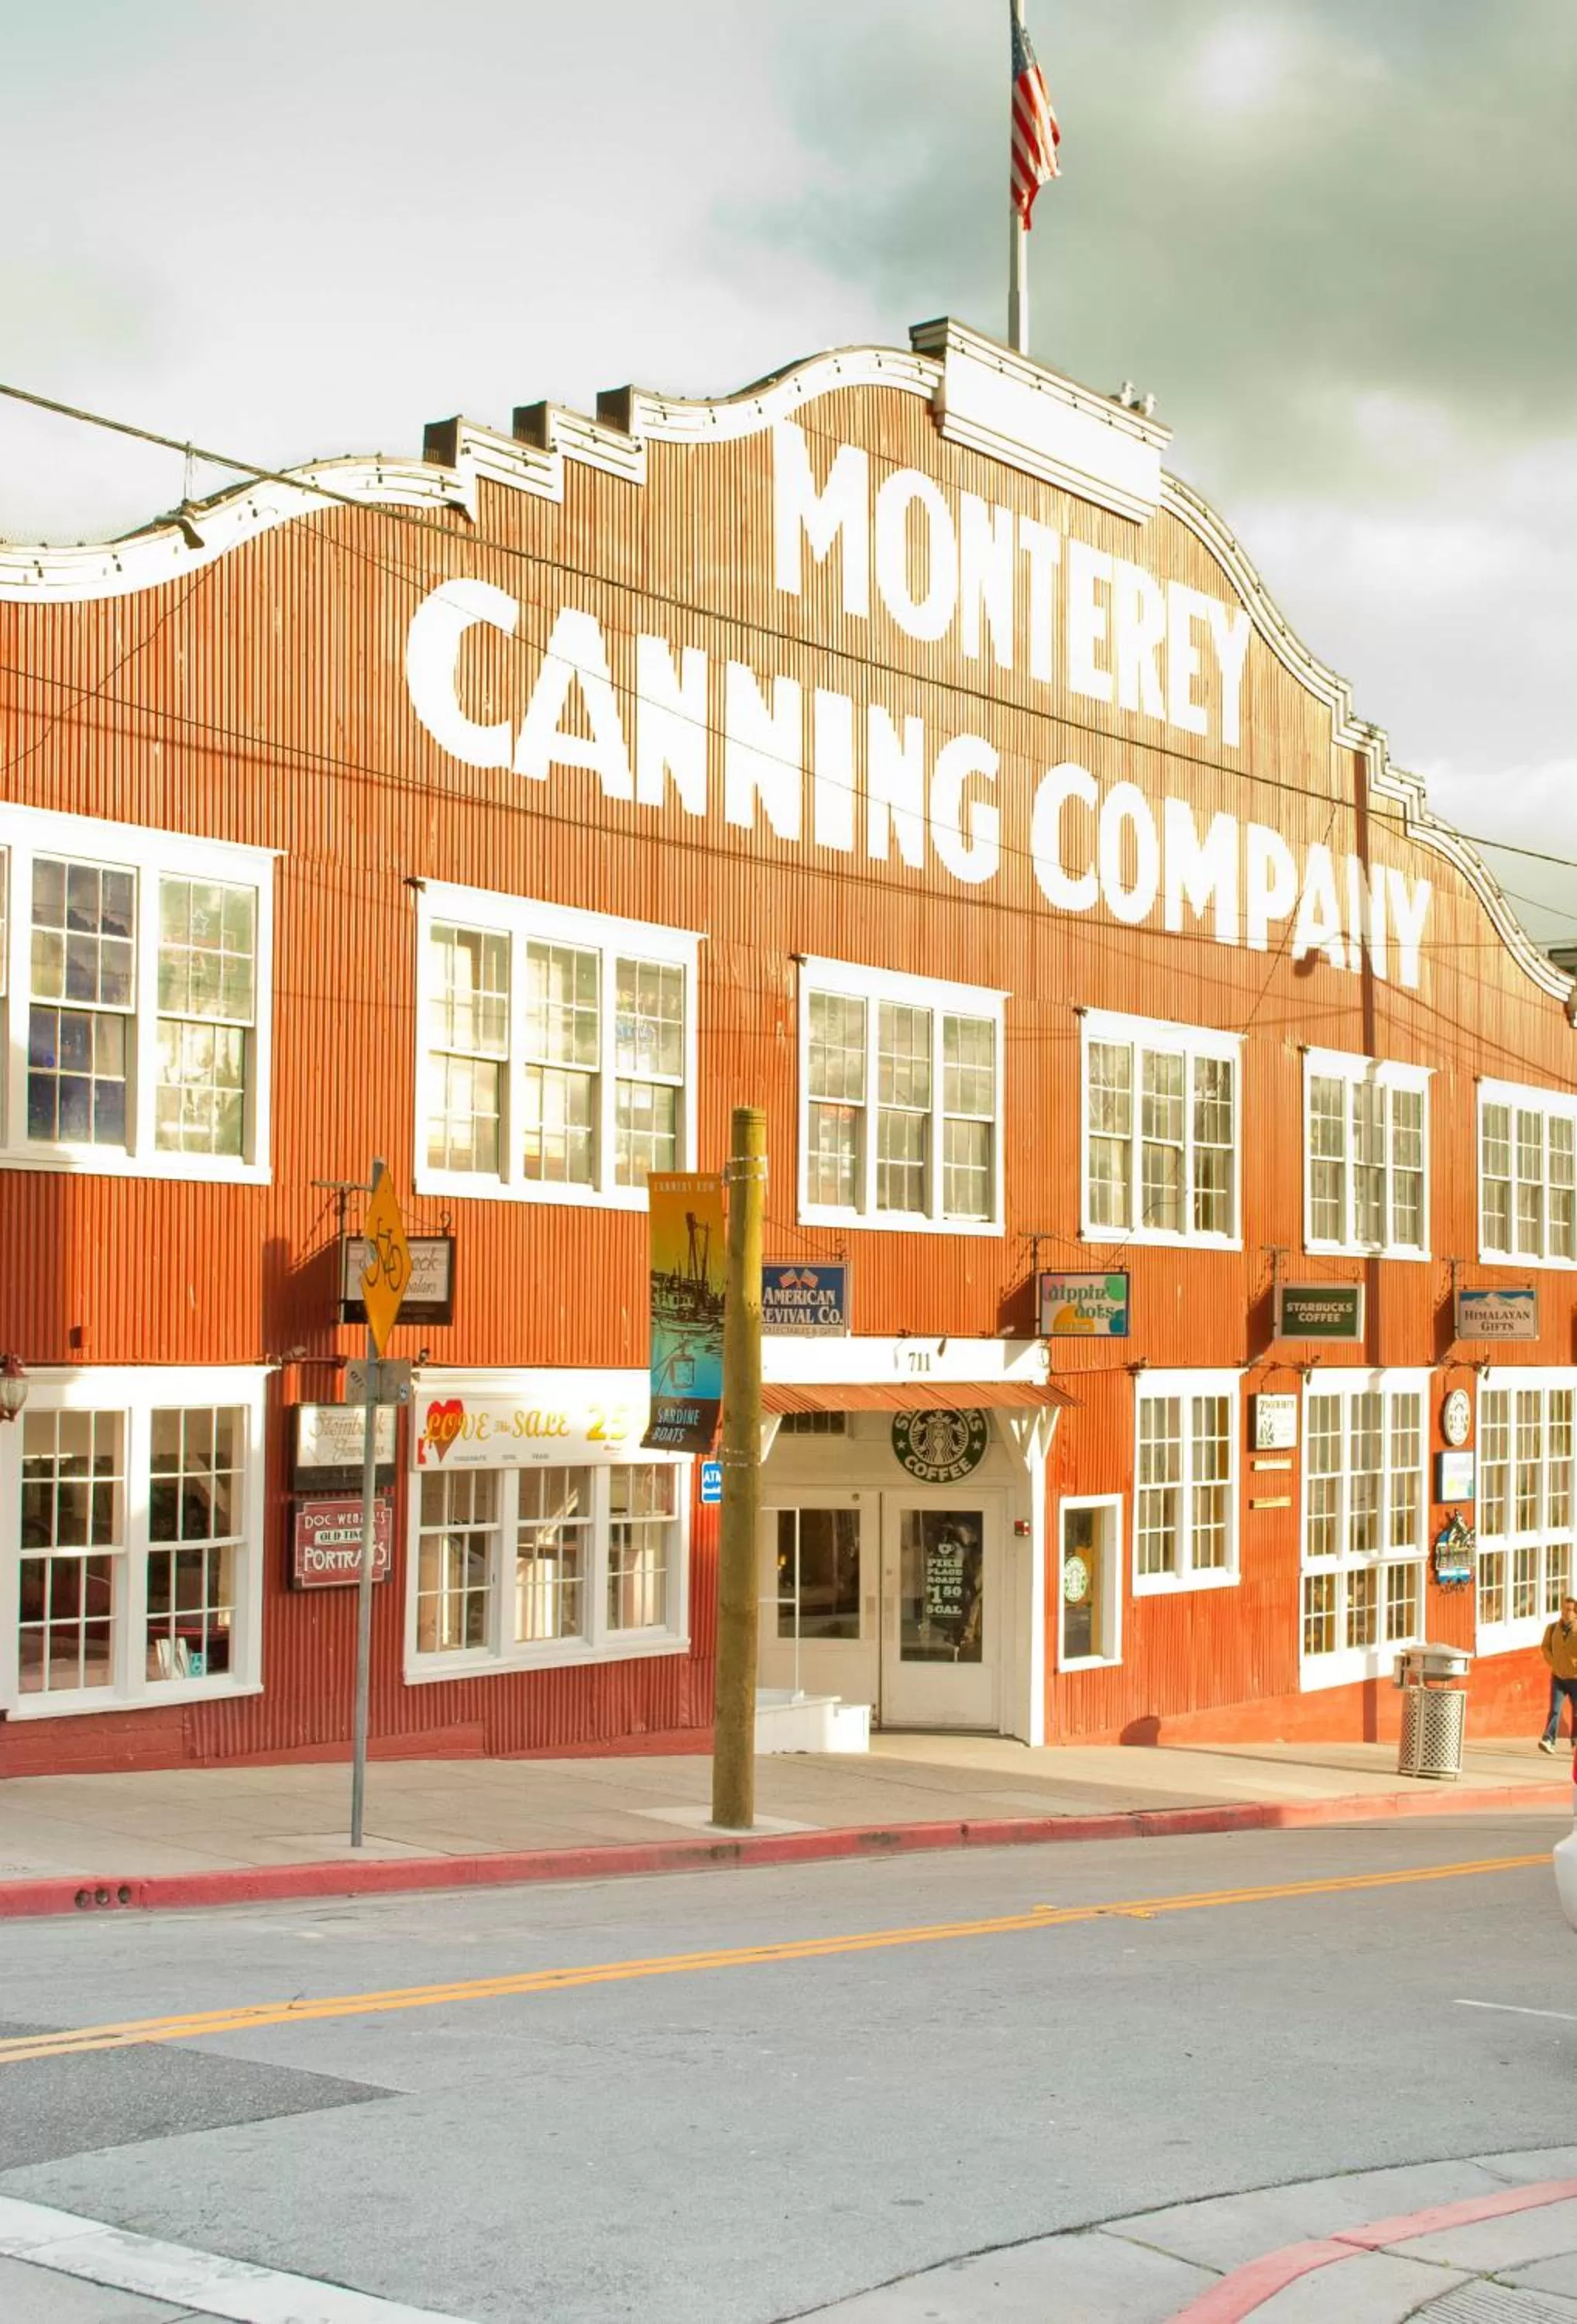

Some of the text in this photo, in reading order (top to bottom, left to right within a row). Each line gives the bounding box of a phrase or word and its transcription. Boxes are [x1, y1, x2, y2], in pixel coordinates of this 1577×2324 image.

[771, 417, 1252, 748] MONTEREY
[406, 577, 1433, 989] CANNING COMPANY
[763, 1286, 836, 1305] AMERICAN
[1074, 1303, 1114, 1319] dots
[1287, 1302, 1354, 1313] STARBUCKS
[1465, 1310, 1531, 1320] HIMALAYAN
[1298, 1312, 1342, 1322] COFFEE
[1481, 1321, 1514, 1331] GIFTS
[909, 1352, 931, 1372] 711
[658, 1407, 700, 1426] SARDINE
[425, 1412, 492, 1441] LOVE
[512, 1410, 572, 1439] SALE
[651, 1426, 687, 1443] BOATS
[905, 1455, 973, 1482] COFFEE
[304, 1514, 332, 1530] DOC
[320, 1531, 342, 1541] OLD
[927, 1558, 963, 1568] PIKE
